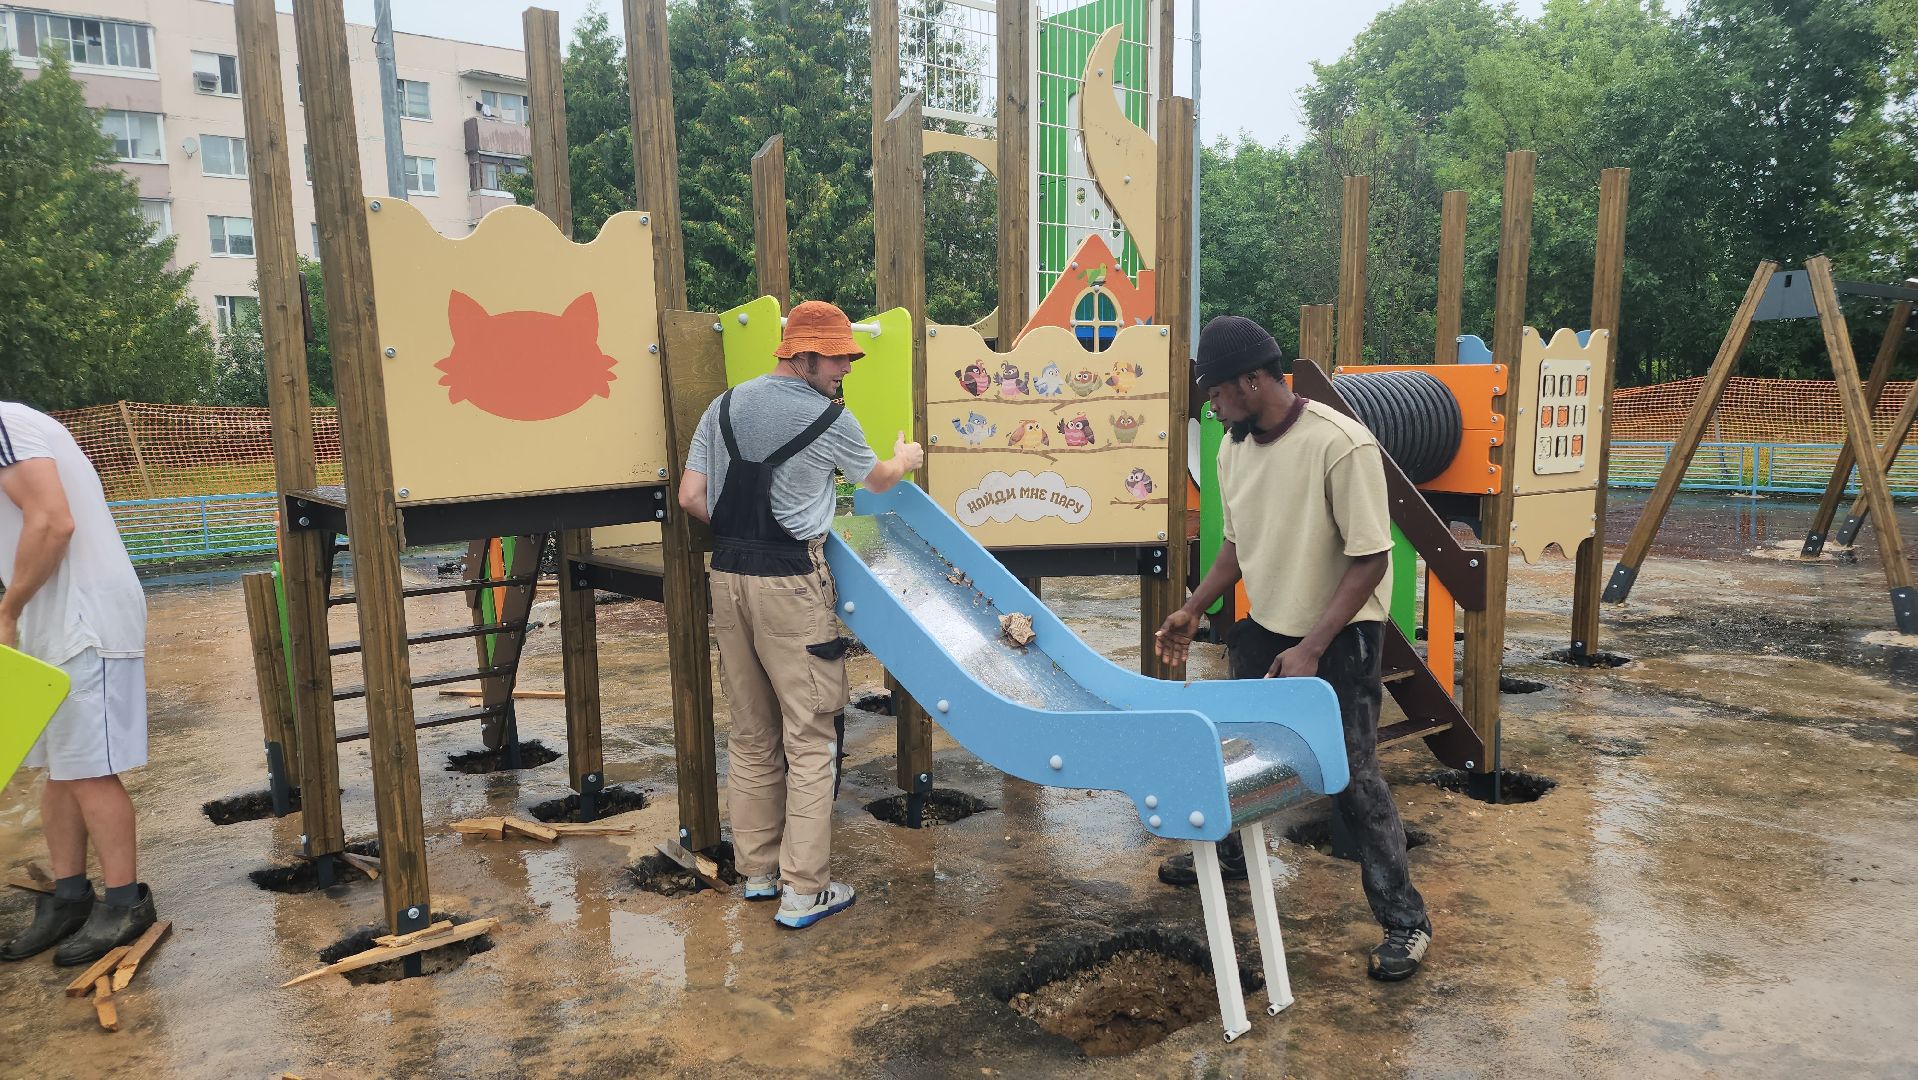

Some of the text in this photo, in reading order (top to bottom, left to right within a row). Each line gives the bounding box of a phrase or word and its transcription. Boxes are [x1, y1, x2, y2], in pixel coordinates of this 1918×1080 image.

[966, 486, 1084, 514] НАЙДИ МНЕ ПАРУ
